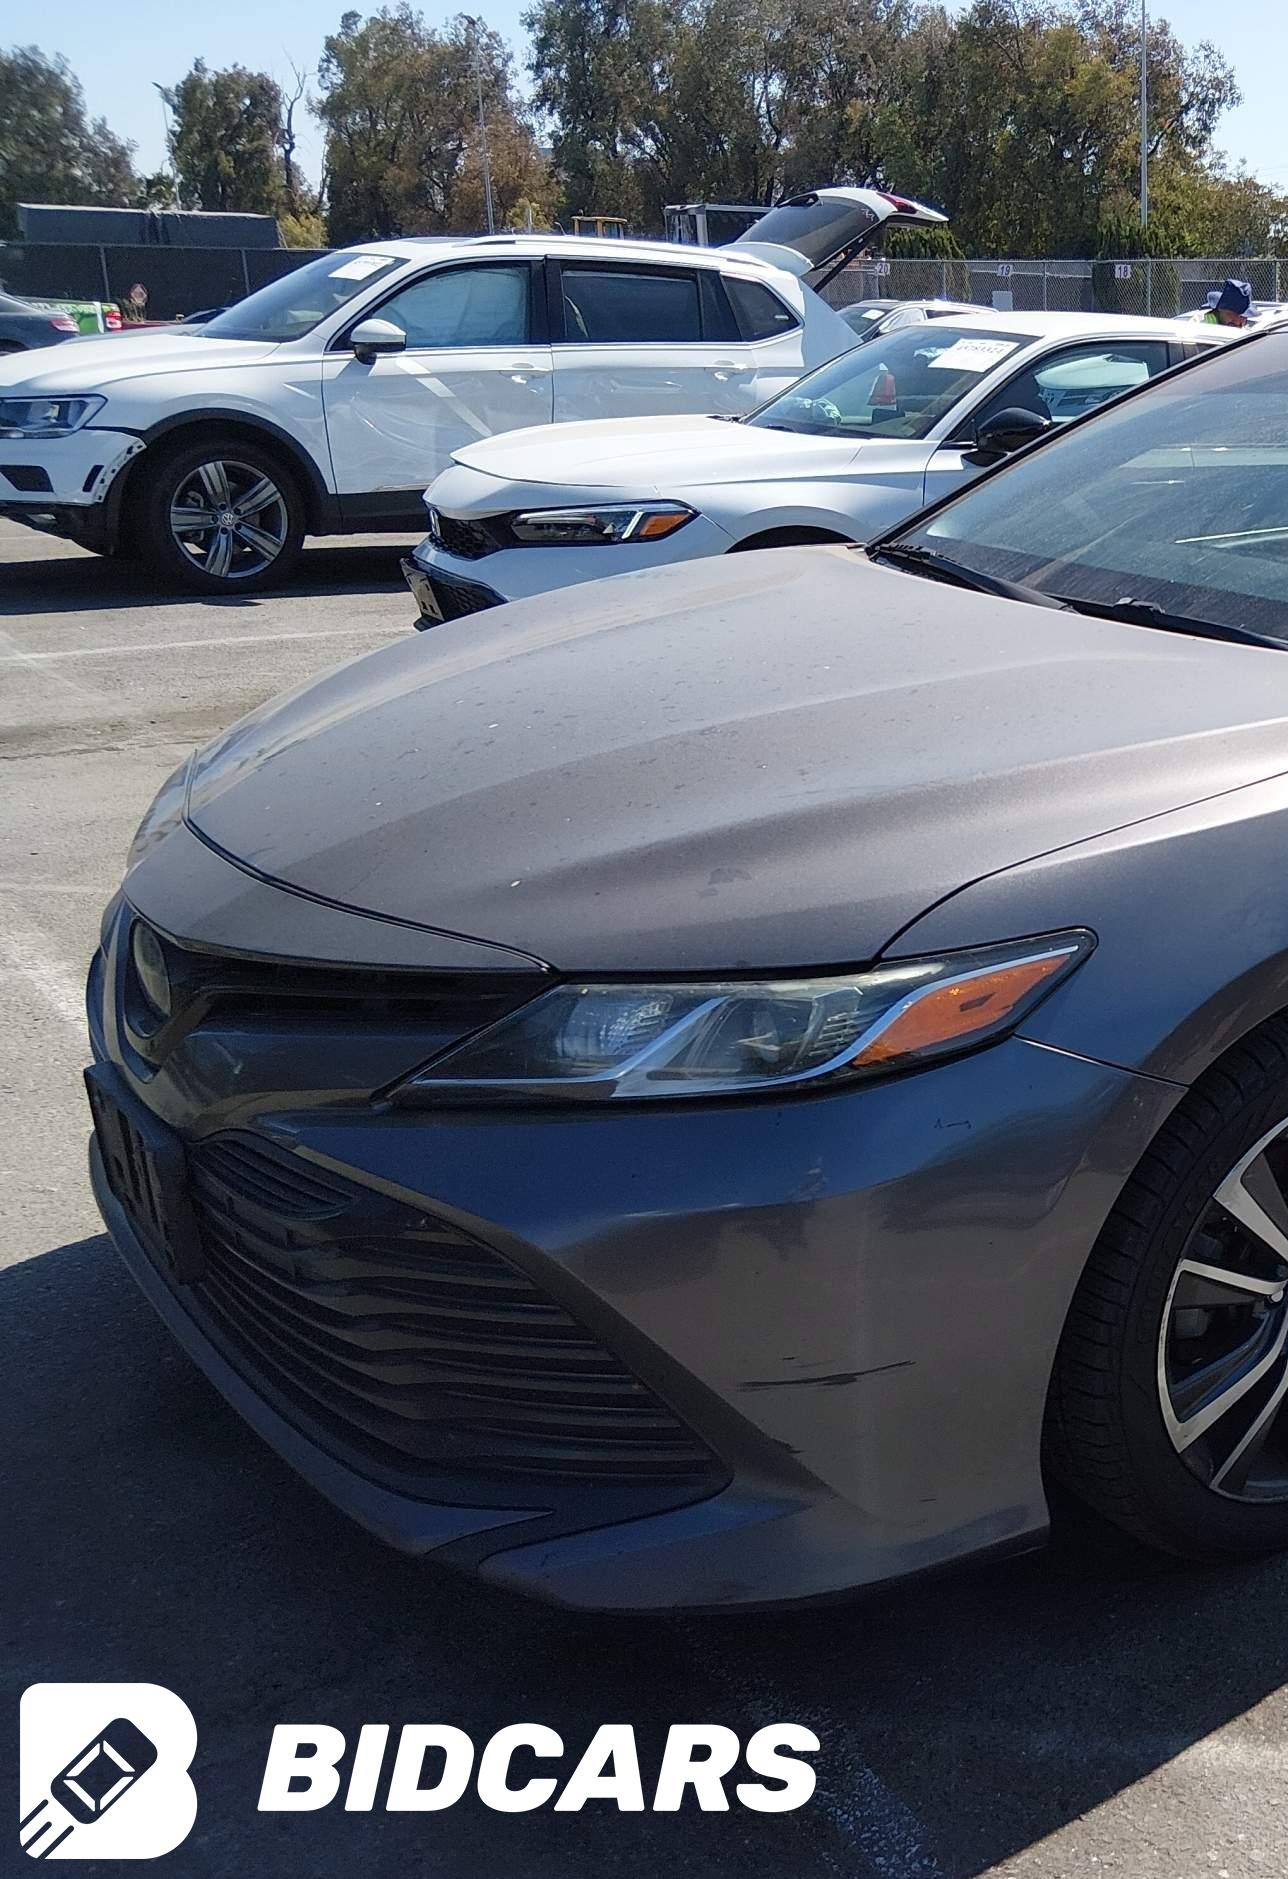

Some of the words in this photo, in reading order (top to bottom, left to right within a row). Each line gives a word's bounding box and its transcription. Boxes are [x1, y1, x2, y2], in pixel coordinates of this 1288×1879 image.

[879, 263, 889, 273] 20
[1000, 265, 1010, 276] 19
[1118, 265, 1128, 278] 18
